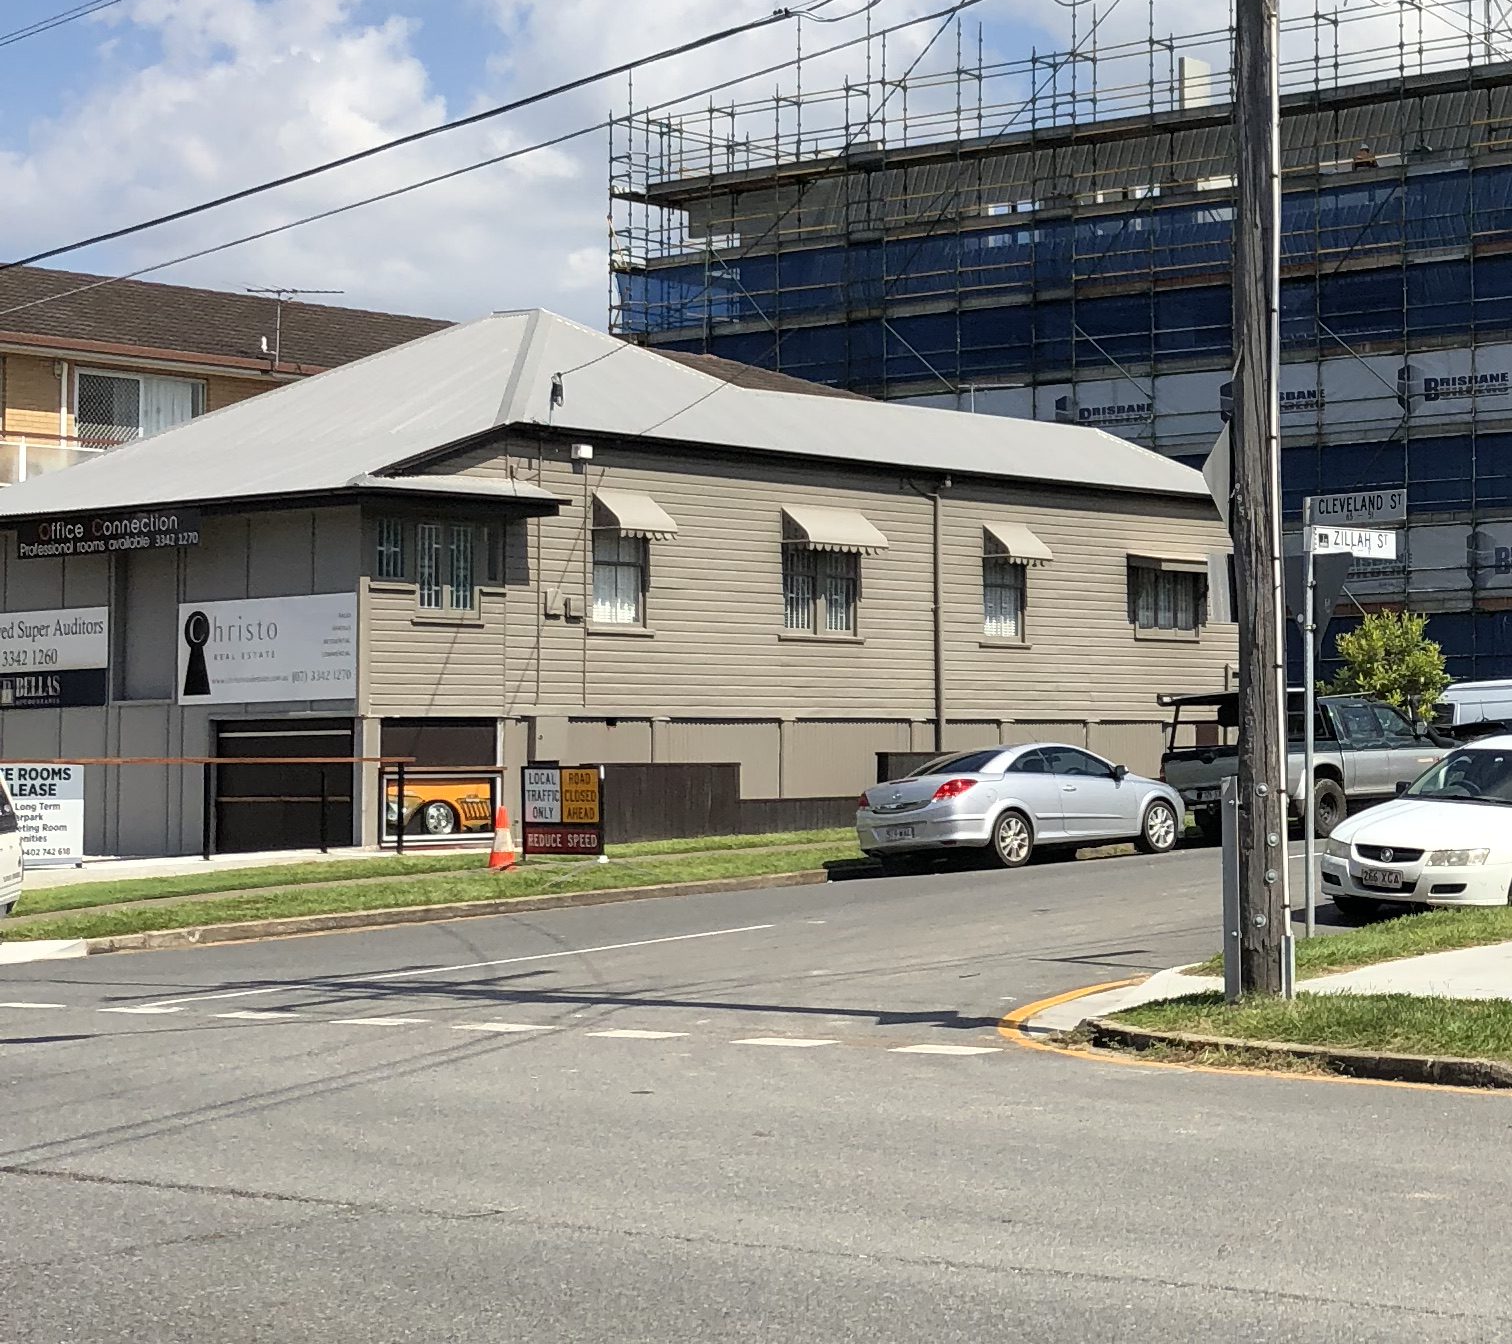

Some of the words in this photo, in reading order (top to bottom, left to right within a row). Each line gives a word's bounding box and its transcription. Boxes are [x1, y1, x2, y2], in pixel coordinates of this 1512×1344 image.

[1319, 495, 1383, 515] CLEVELAND
[1390, 494, 1401, 509] ST
[39, 522, 84, 541] Office
[92, 515, 178, 536] Connection
[20, 542, 73, 556] Professional
[77, 540, 105, 552] rooms
[109, 536, 150, 550] available
[155, 534, 175, 546] 3342
[178, 532, 198, 545] 1270
[1333, 531, 1371, 548] ZILLAH
[1377, 534, 1388, 548] ST
[18, 621, 50, 642] Super
[53, 617, 104, 636] Auditors
[190, 615, 278, 643] Christo
[2, 650, 27, 666] 3342
[32, 649, 58, 665] 1260
[214, 653, 235, 661] REAL
[311, 670, 331, 682] 3342
[334, 668, 352, 681] 1270
[18, 767, 72, 781] ROOMS
[529, 772, 557, 785] LOCAL
[568, 772, 591, 785] ROAD
[10, 783, 57, 796] LEASE
[526, 789, 560, 803] TRAFFIC
[564, 789, 597, 803] CLOSED
[15, 803, 37, 812] Long
[39, 802, 61, 811] Term
[532, 806, 554, 820] ONLY
[567, 806, 596, 820] AHEAD
[42, 824, 67, 832] Room
[527, 833, 562, 847] REDUCE
[567, 834, 598, 848] SPEED
[42, 848, 56, 856] 742
